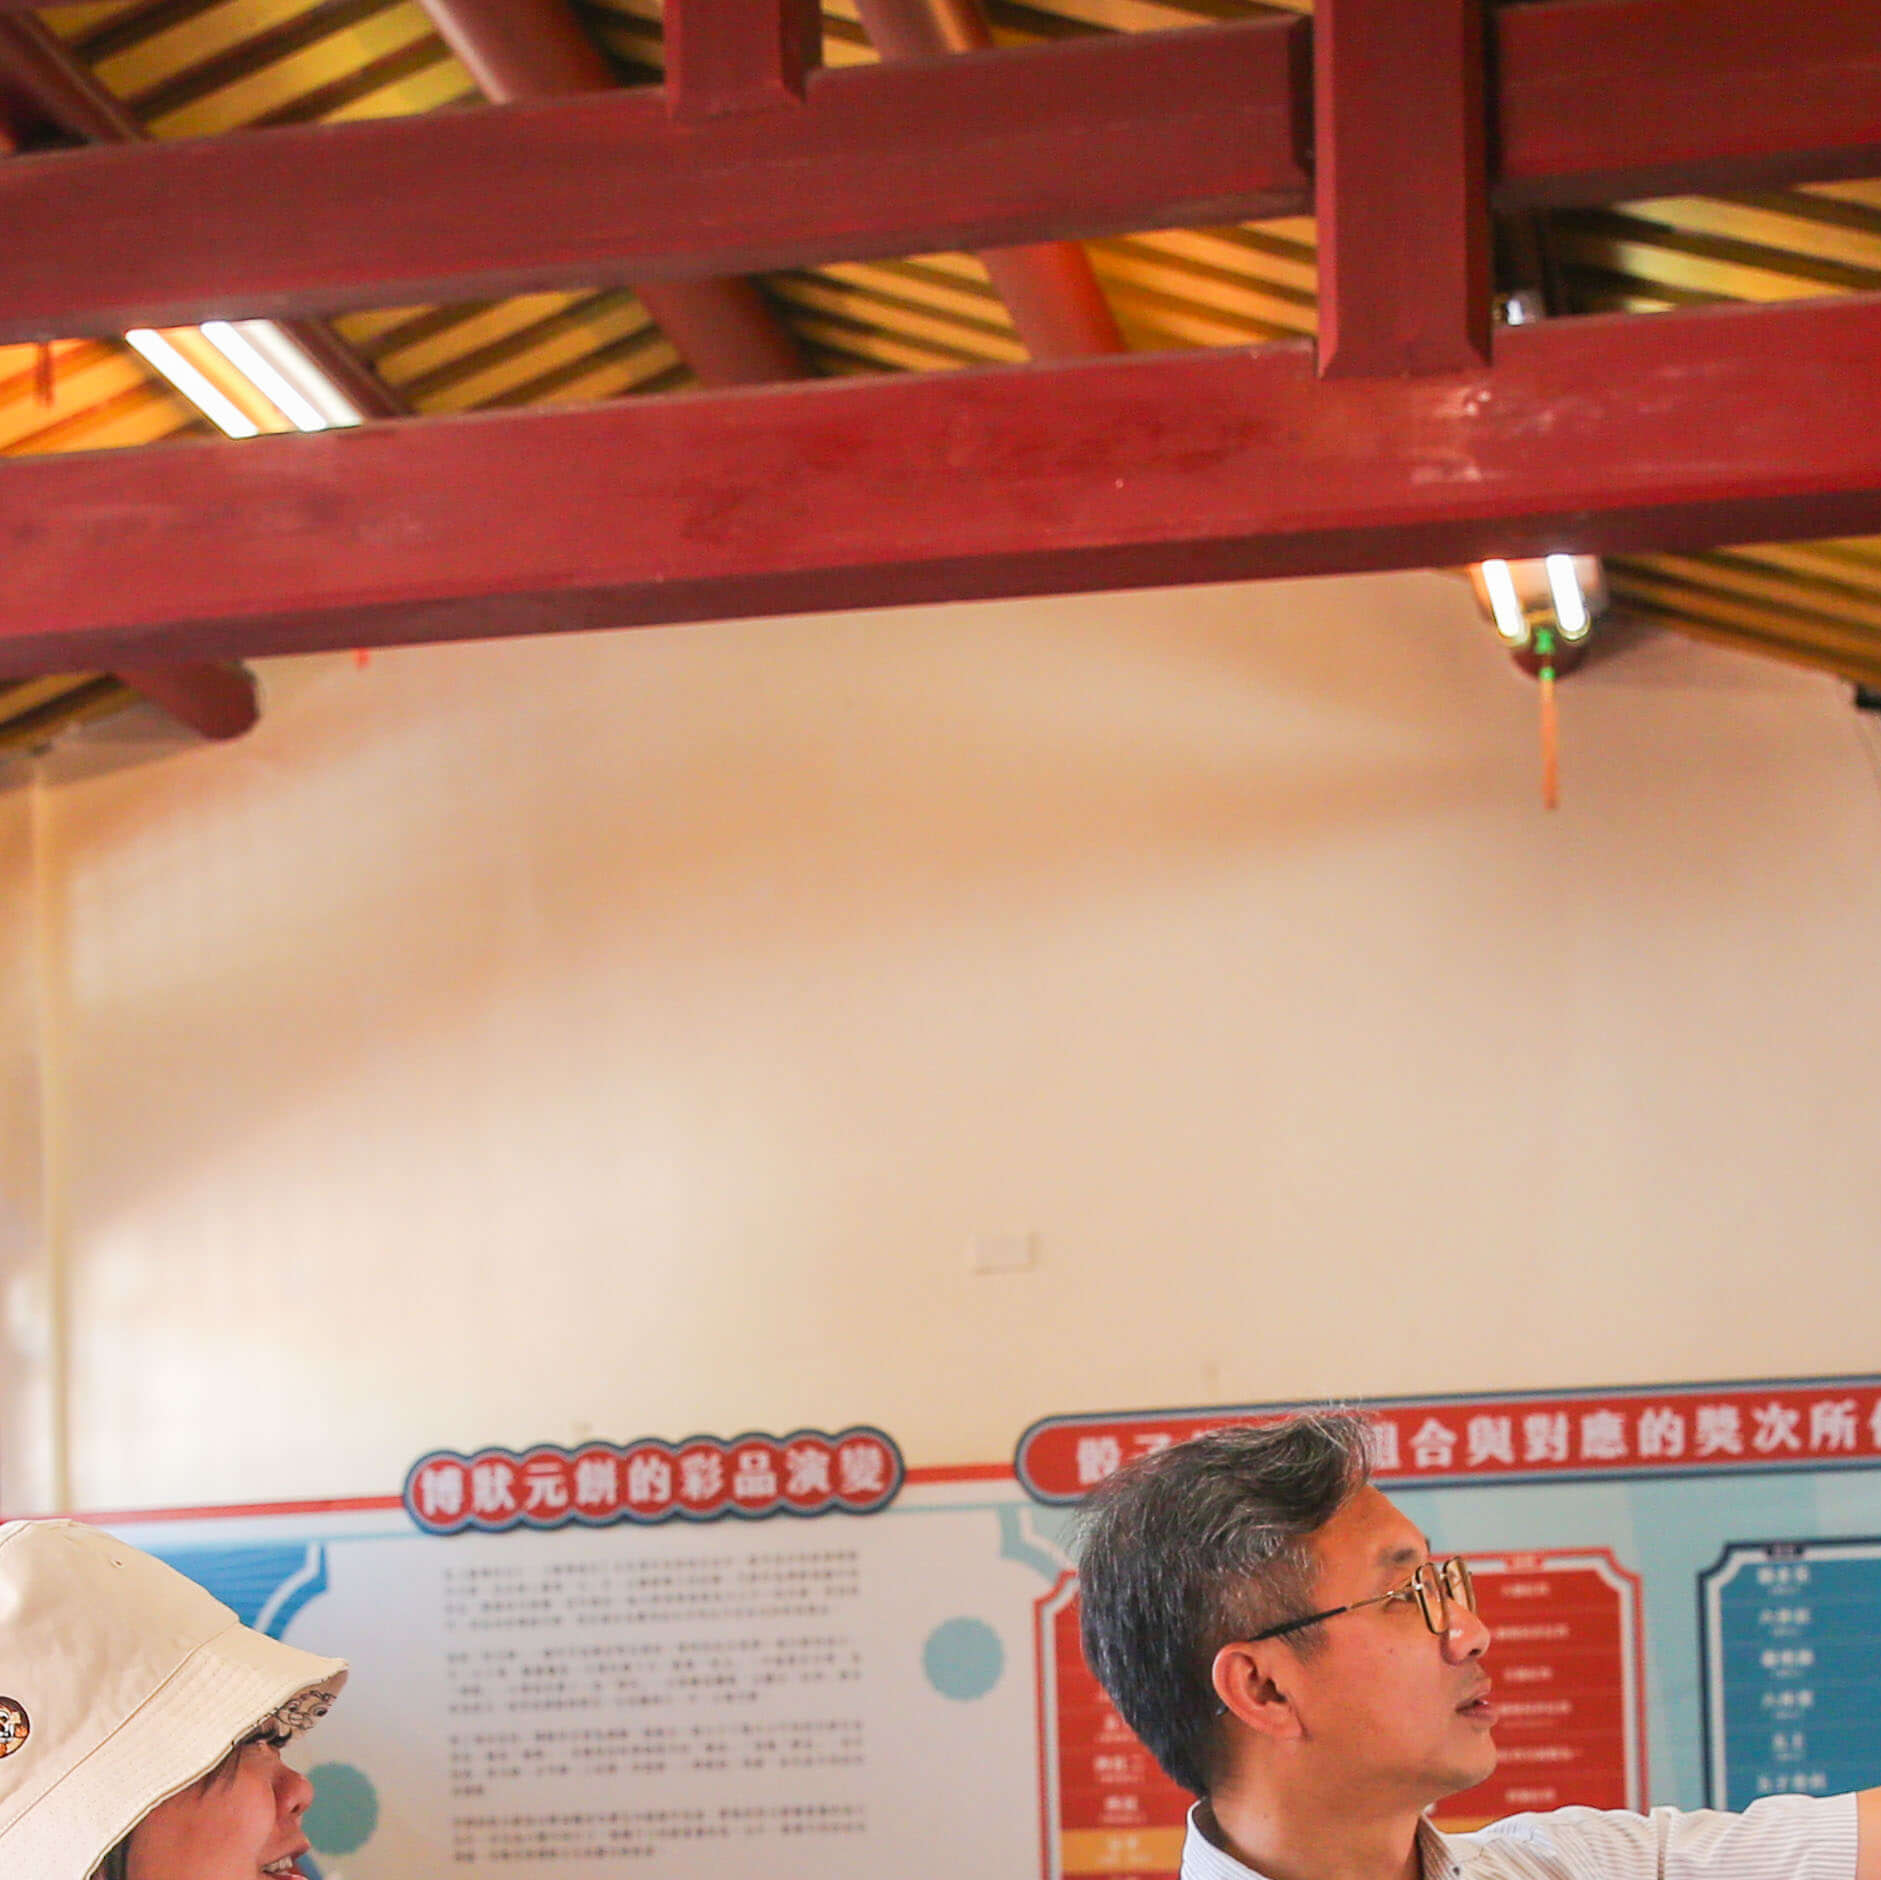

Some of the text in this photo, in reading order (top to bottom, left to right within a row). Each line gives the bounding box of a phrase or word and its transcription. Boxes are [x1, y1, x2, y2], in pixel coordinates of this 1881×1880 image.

[422, 1444, 884, 1517] 博狀元餅的彩品演變
